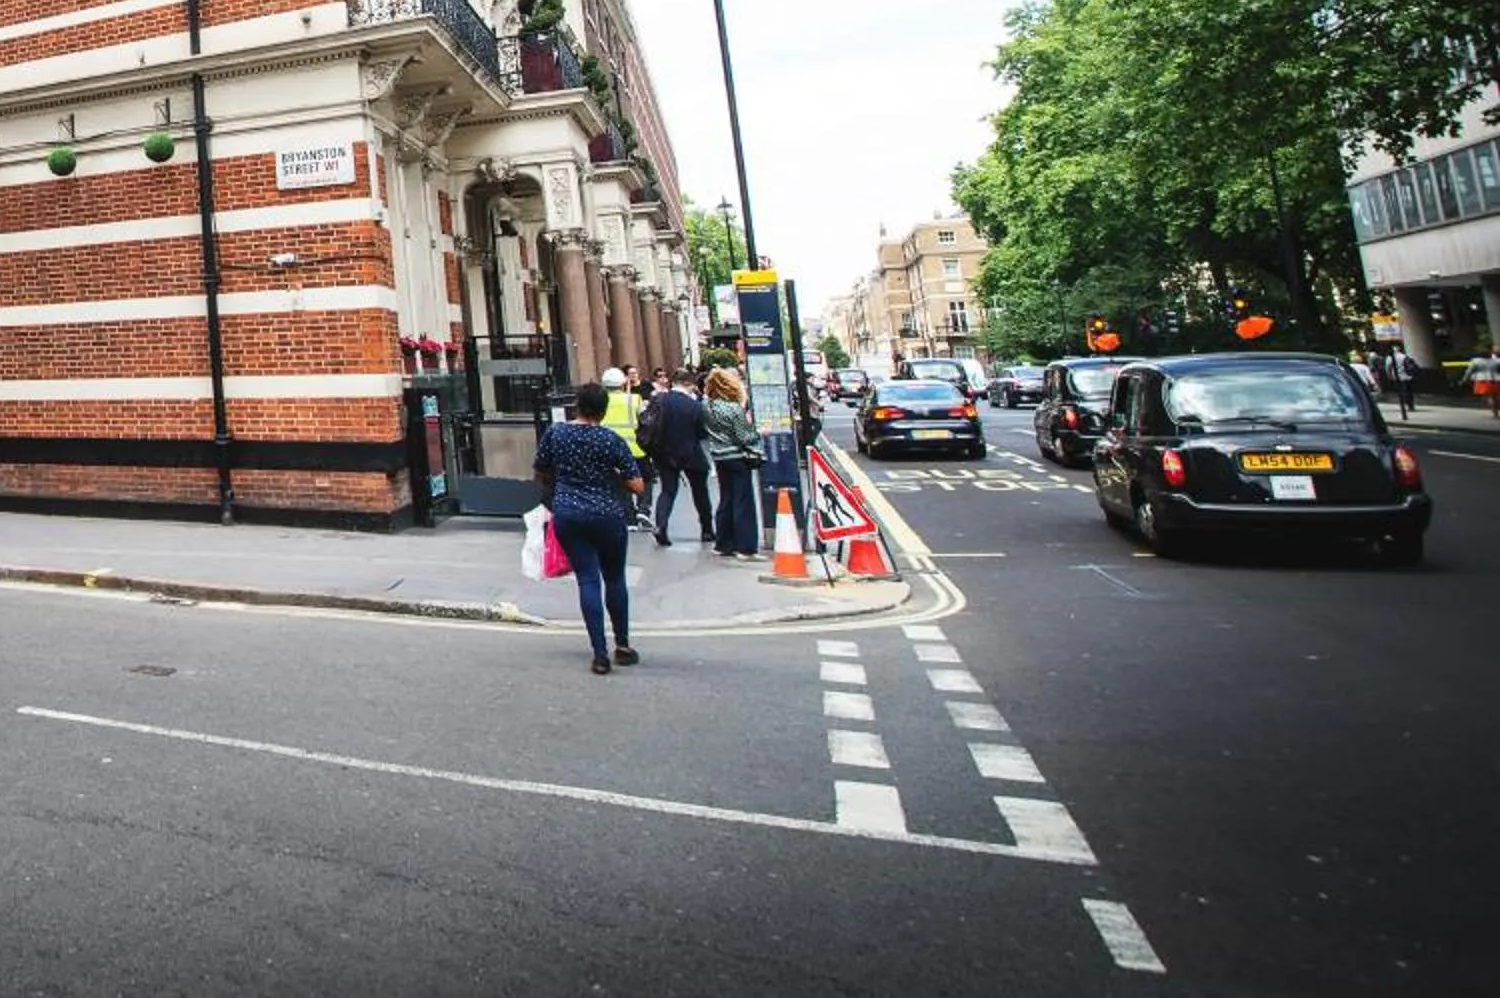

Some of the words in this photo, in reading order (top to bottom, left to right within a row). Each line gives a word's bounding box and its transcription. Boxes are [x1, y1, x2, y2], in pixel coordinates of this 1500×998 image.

[281, 147, 347, 163] BRYANSTON
[283, 162, 320, 176] STREET
[884, 469, 1024, 479] BUS
[875, 479, 1070, 492] STOP
